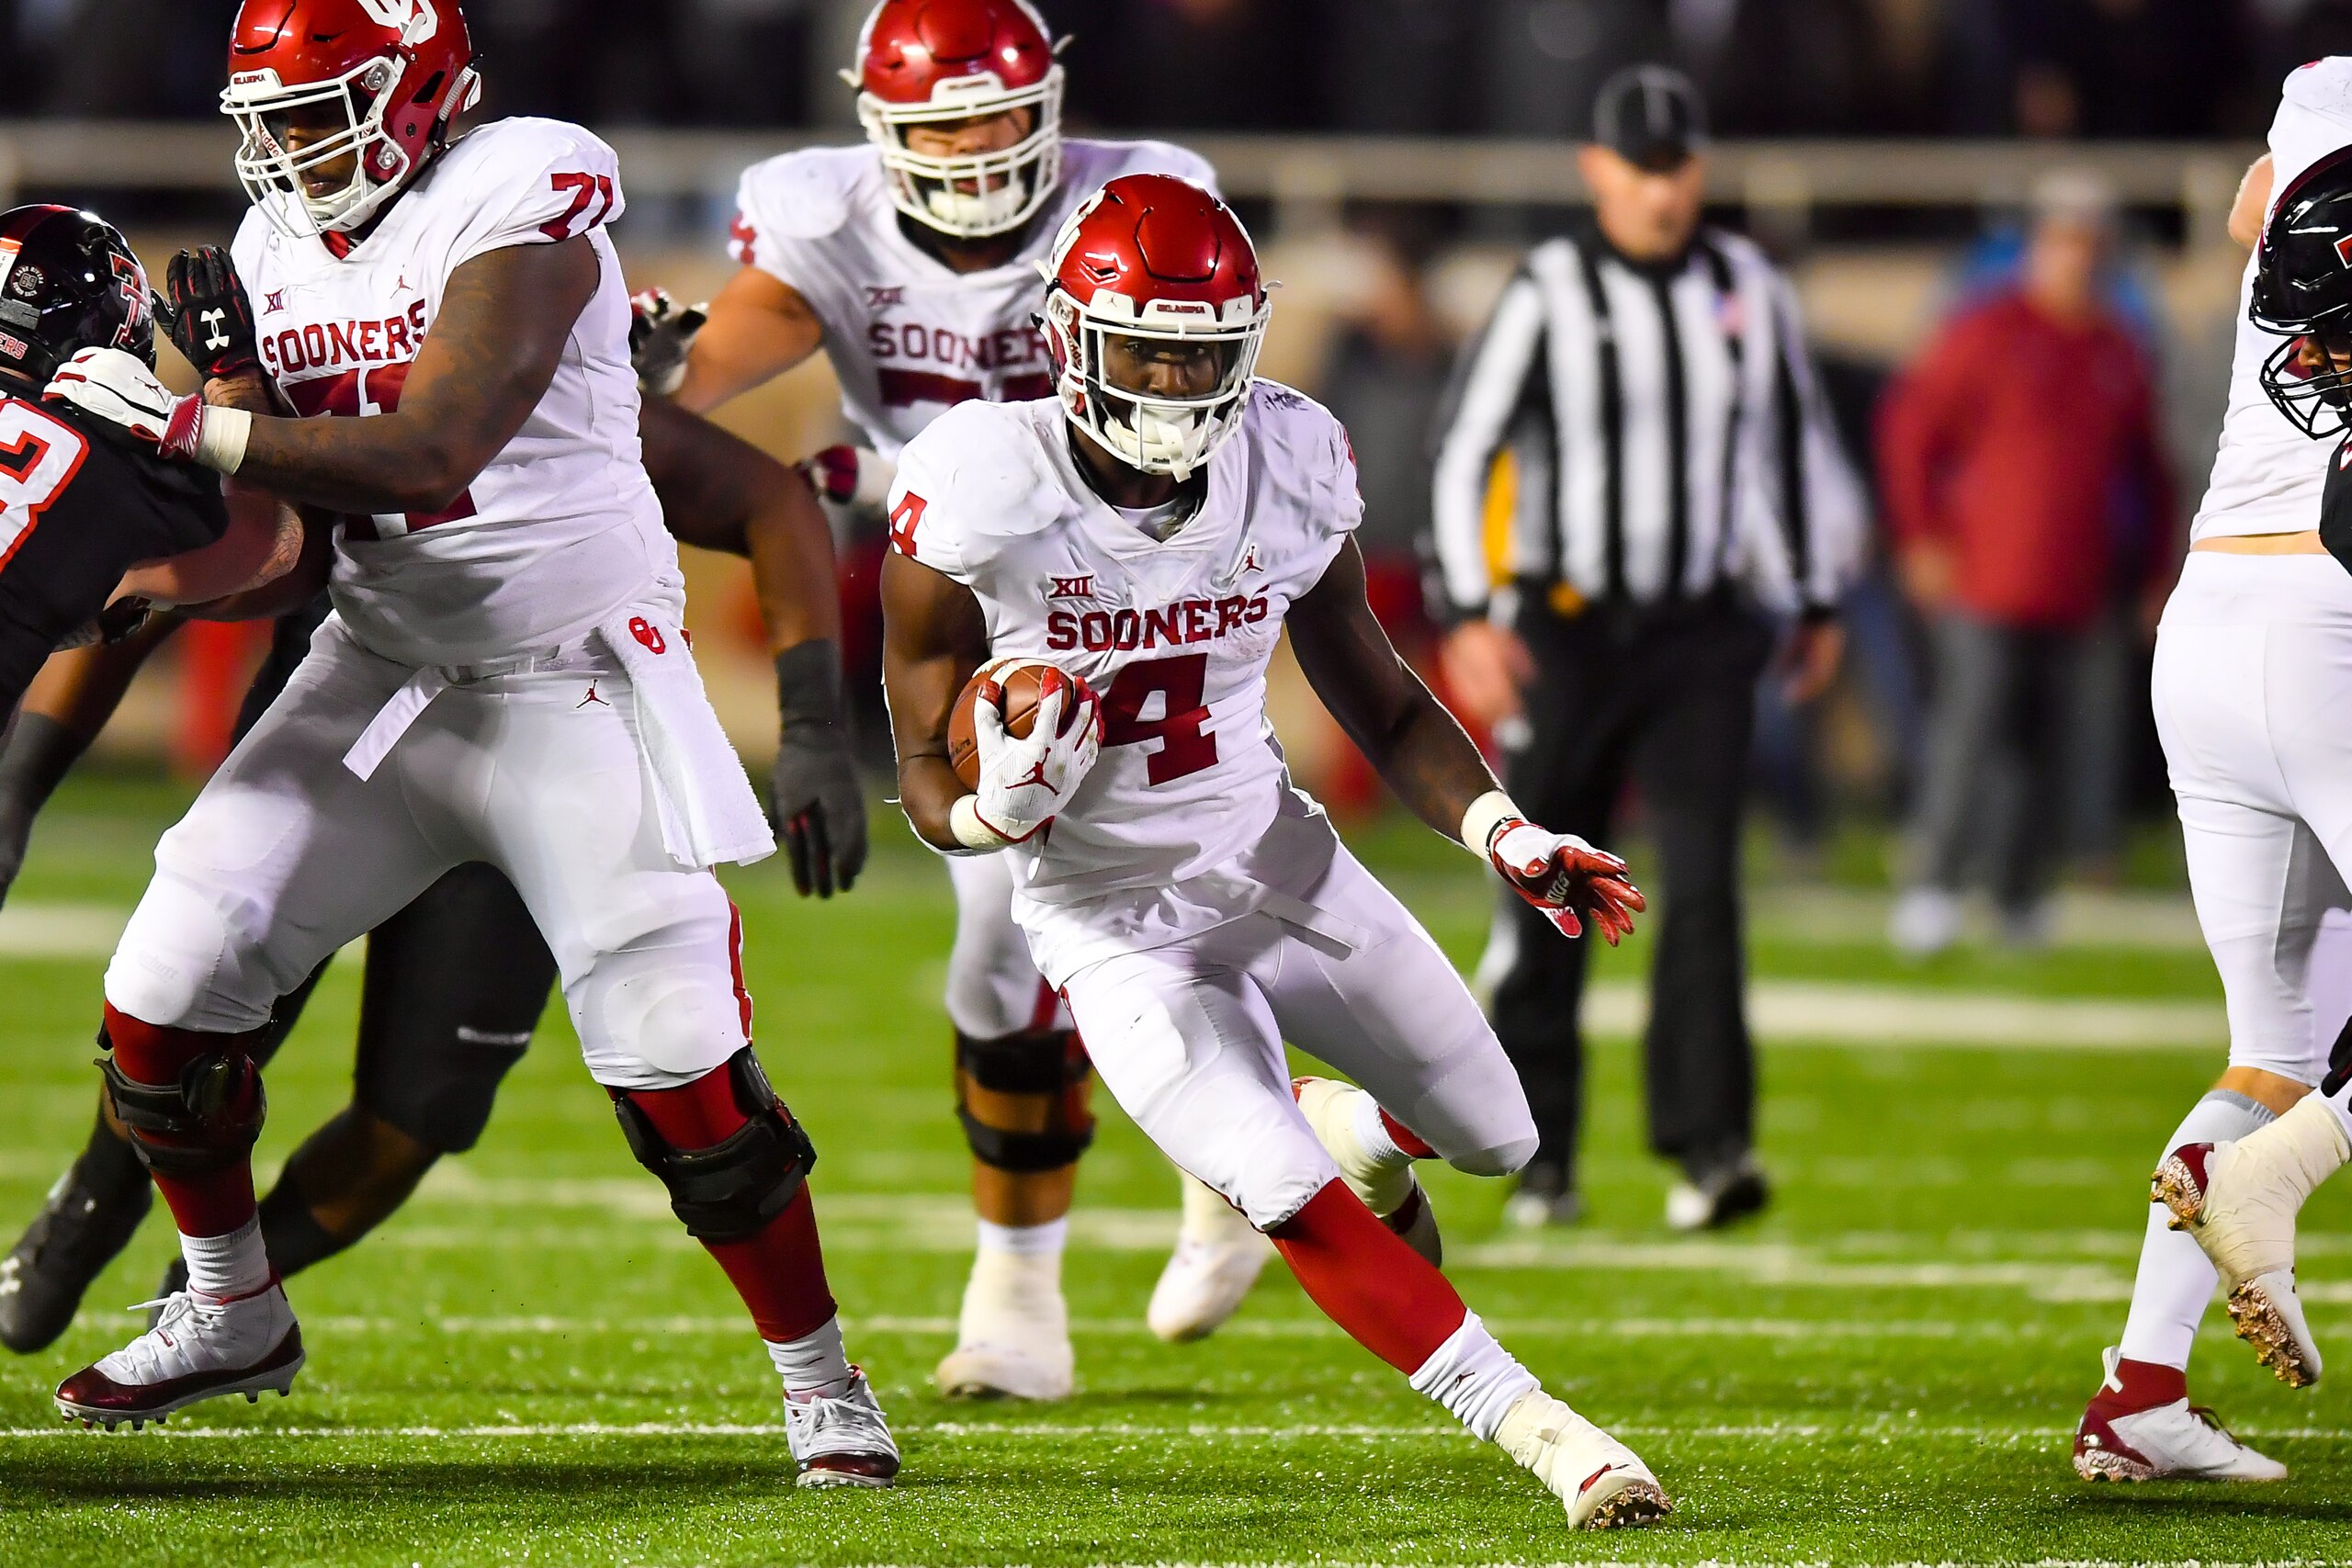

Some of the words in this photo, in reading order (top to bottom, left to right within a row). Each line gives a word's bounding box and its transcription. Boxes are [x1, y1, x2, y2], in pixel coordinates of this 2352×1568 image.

[539, 172, 613, 242] 71
[262, 298, 425, 379] SOONERS
[867, 322, 1053, 368] SOONER
[890, 490, 928, 557] 4
[1046, 584, 1270, 653] SOONERS
[1049, 574, 1094, 599] XII
[1101, 652, 1220, 787] 4
